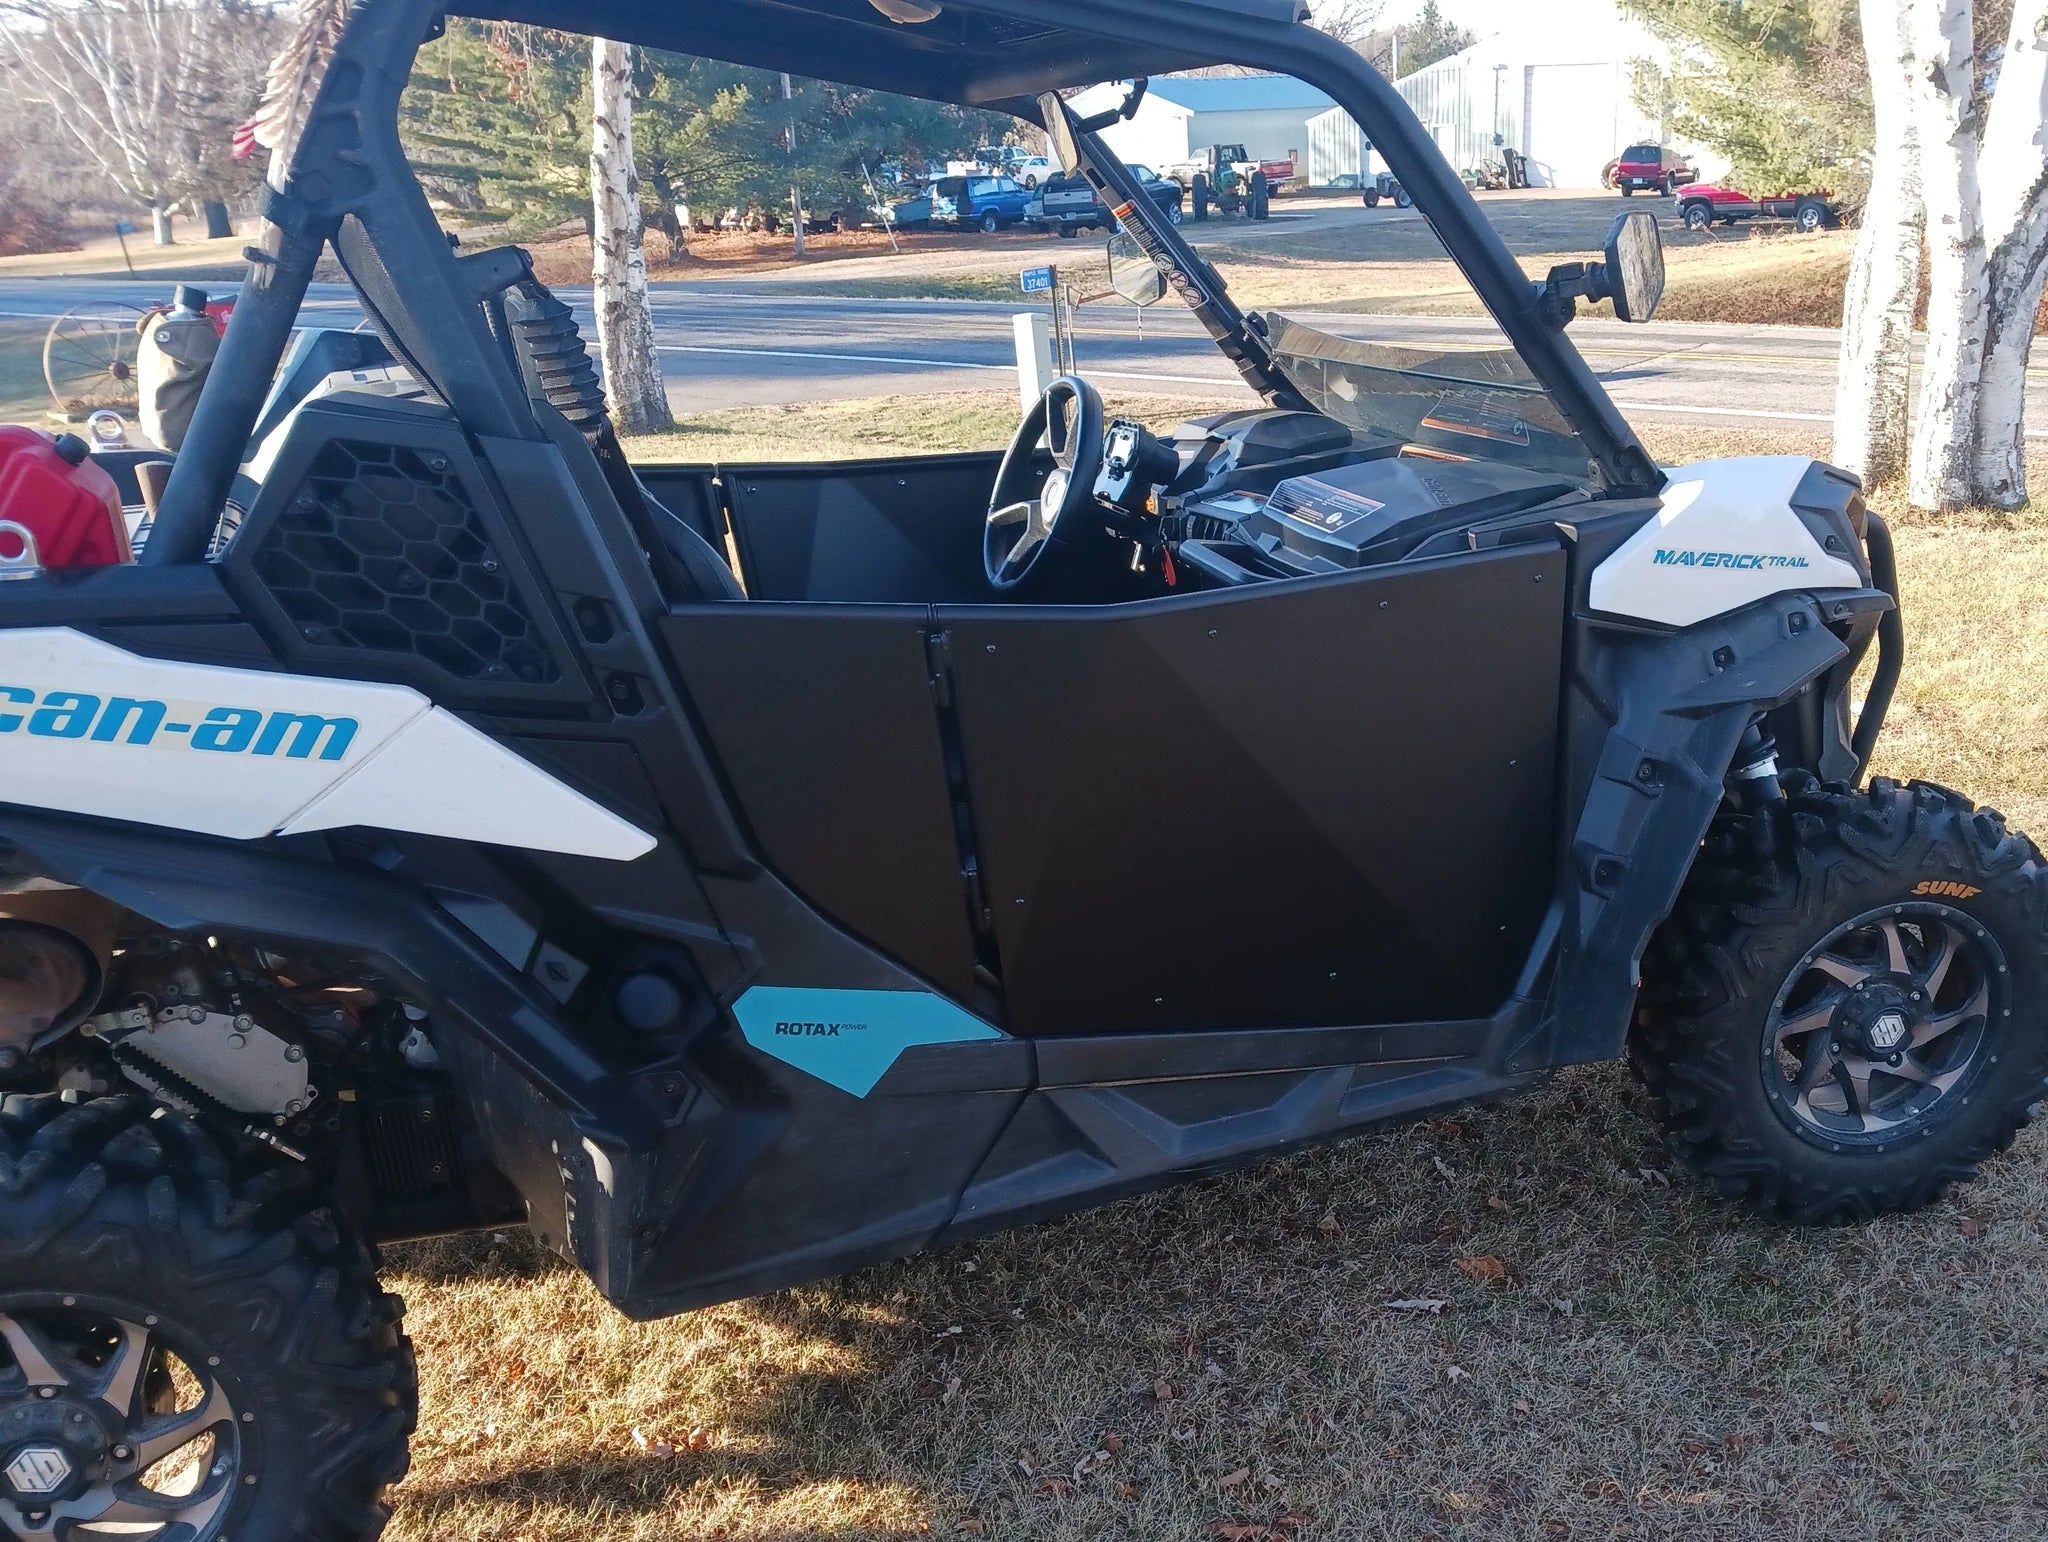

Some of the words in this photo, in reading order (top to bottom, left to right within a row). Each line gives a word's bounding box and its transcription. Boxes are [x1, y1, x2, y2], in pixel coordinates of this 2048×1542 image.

[1026, 276, 1048, 290] 37401
[1653, 549, 1768, 570] MAVERICK
[1768, 556, 1809, 568] TRAIL
[775, 1022, 840, 1036] ROTAX
[840, 1023, 868, 1031] POWER
